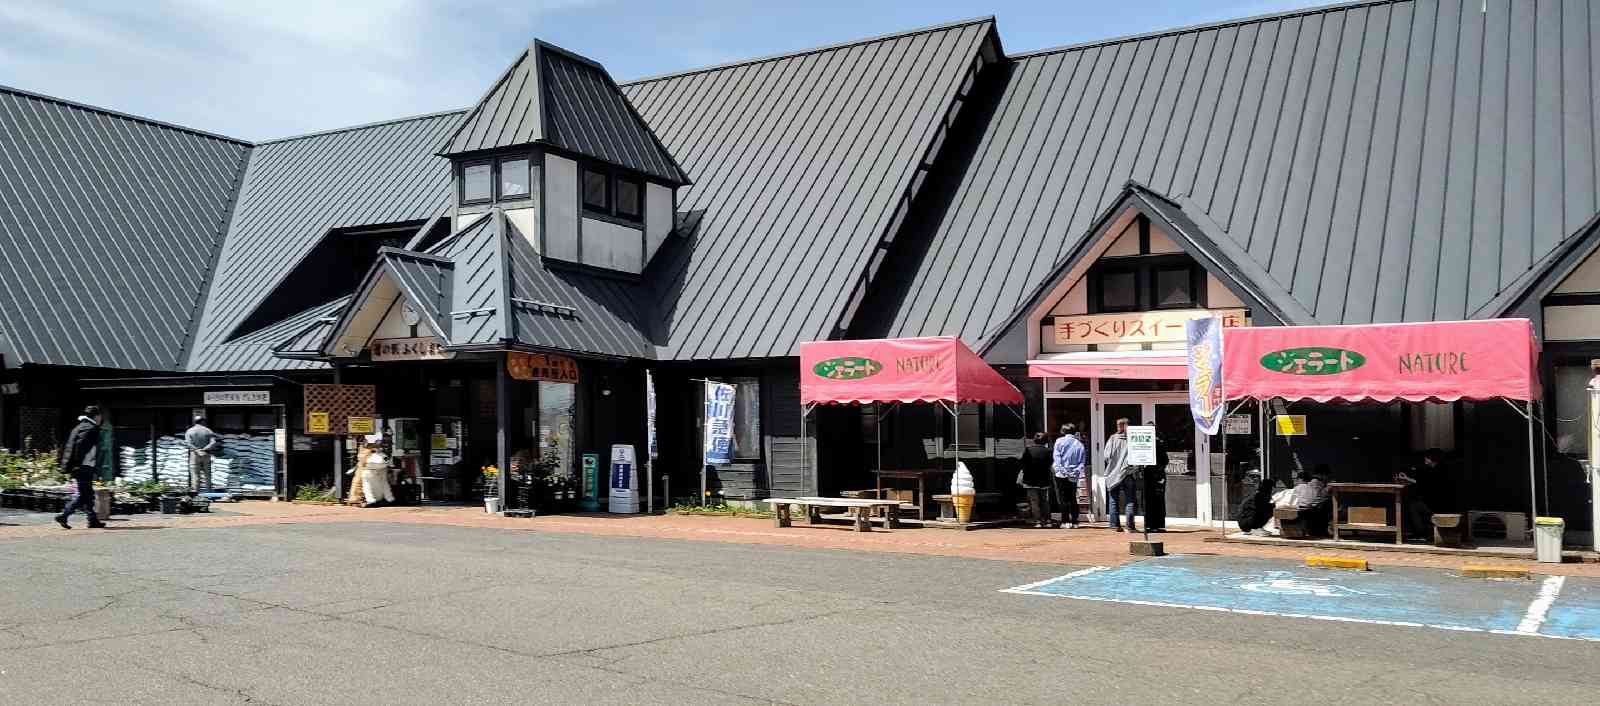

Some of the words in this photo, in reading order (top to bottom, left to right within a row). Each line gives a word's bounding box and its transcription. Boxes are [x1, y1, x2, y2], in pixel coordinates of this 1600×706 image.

[1057, 315, 1240, 340] 手づくりスイー店
[896, 354, 944, 375] NATURE
[1277, 350, 1354, 374] ジェラート
[1398, 351, 1472, 375] NATURE
